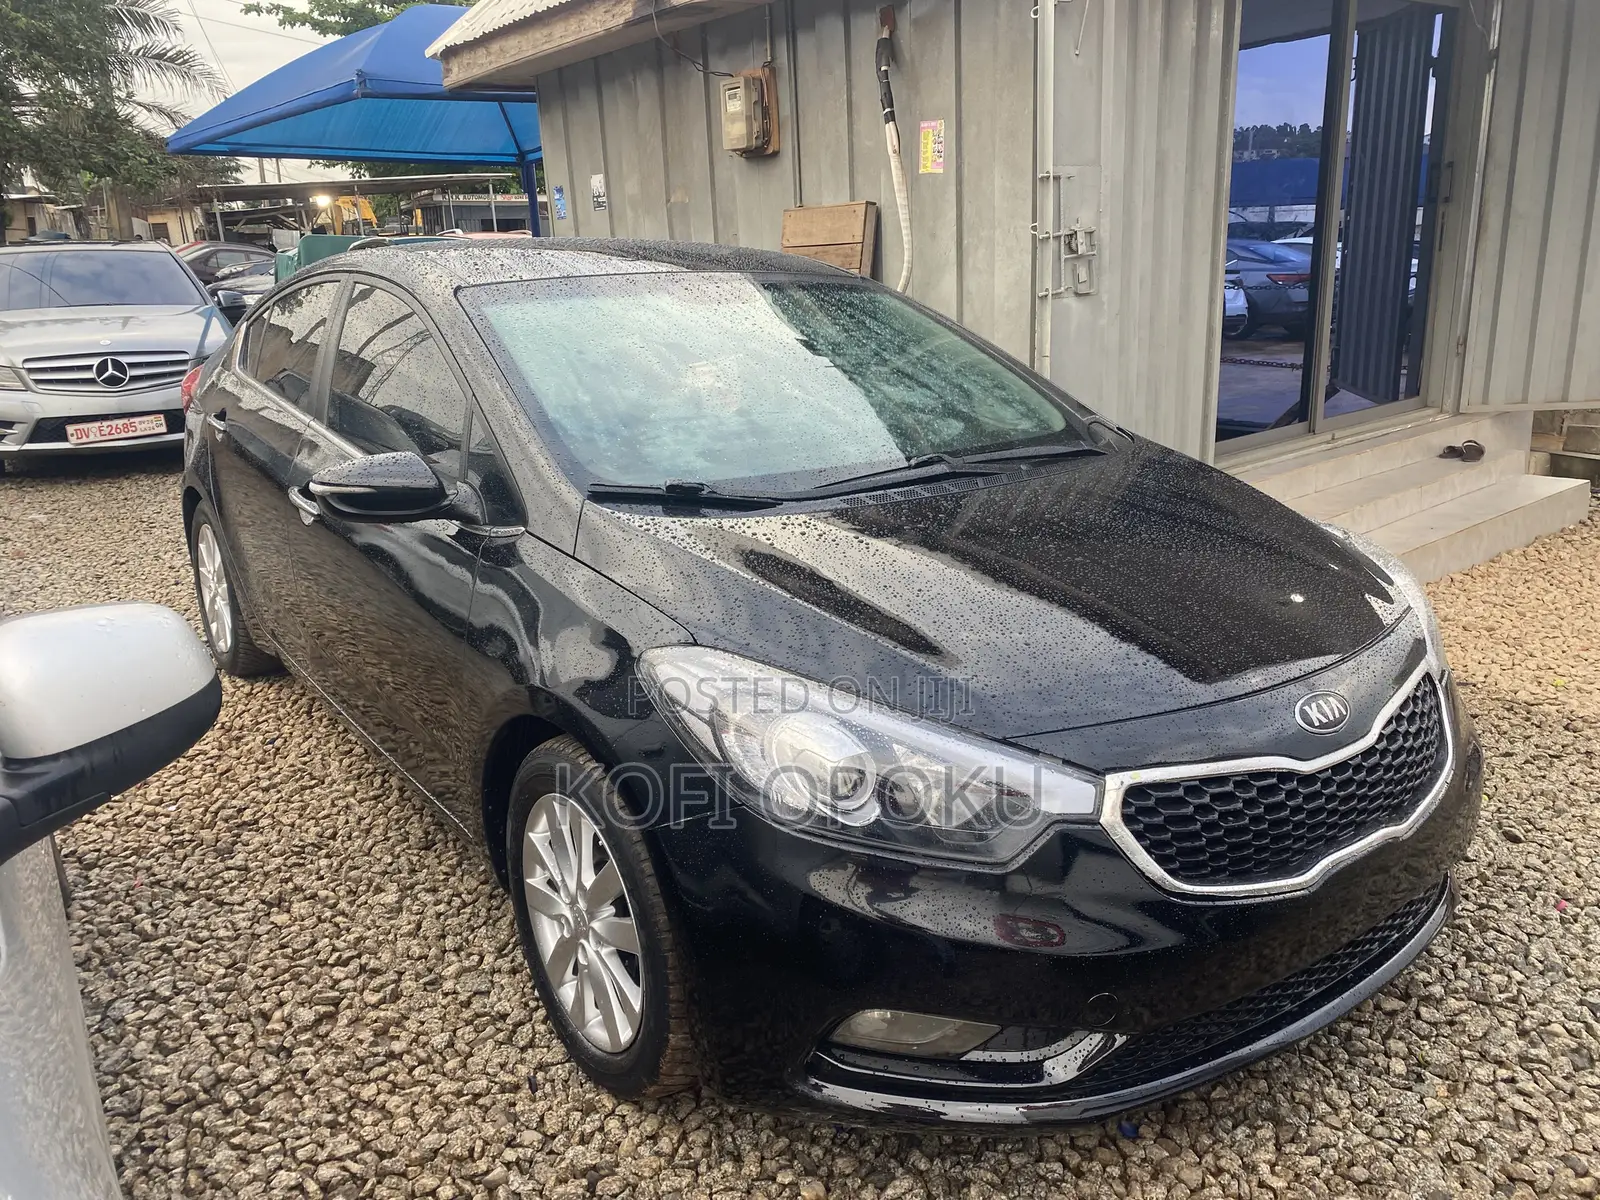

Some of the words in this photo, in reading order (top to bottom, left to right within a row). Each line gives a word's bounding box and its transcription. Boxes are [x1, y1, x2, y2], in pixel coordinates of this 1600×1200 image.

[74, 427, 90, 440] DV
[98, 421, 138, 437] E2685
[1302, 696, 1347, 727] KIA
